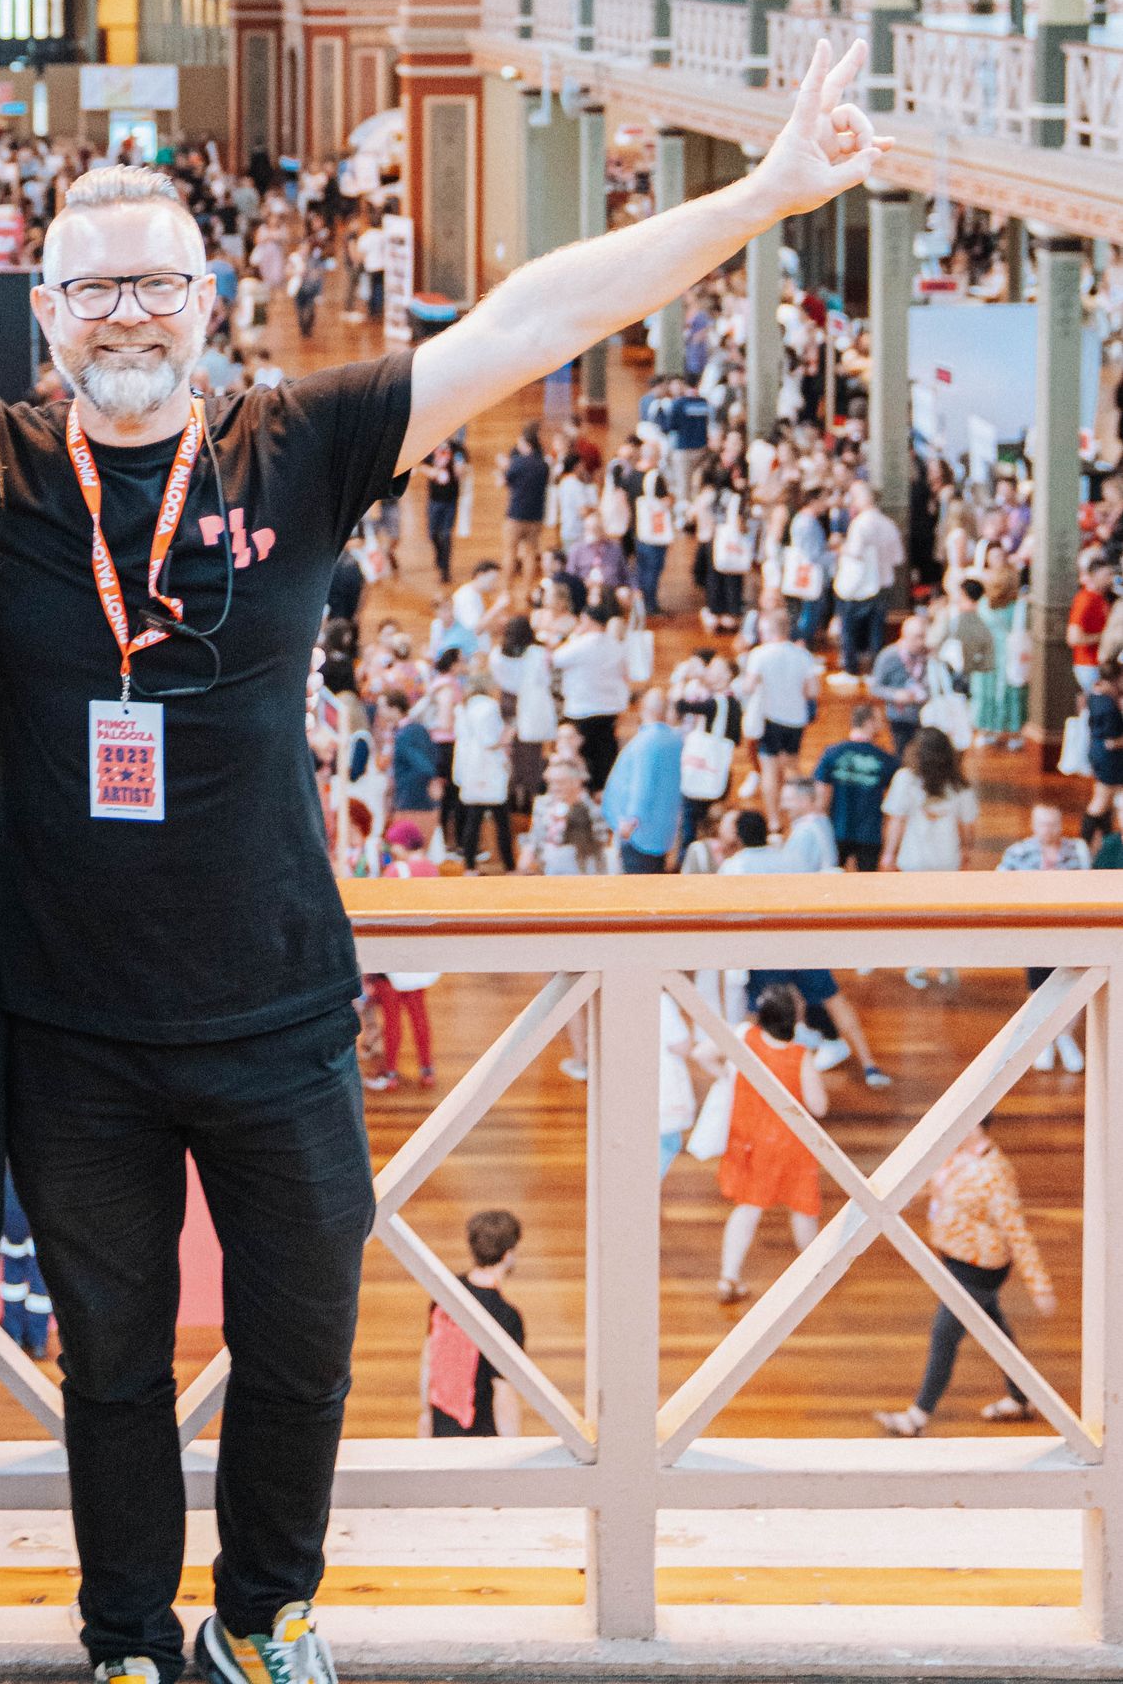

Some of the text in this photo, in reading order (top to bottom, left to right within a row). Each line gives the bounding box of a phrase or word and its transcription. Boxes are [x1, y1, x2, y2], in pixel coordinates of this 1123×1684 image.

[72, 445, 99, 487] PINOT
[157, 464, 191, 535] PALOOZA
[97, 719, 136, 730] PINOT
[97, 730, 155, 741] PALOOZA
[104, 747, 148, 763] 2023
[102, 786, 151, 804] ARTIST
